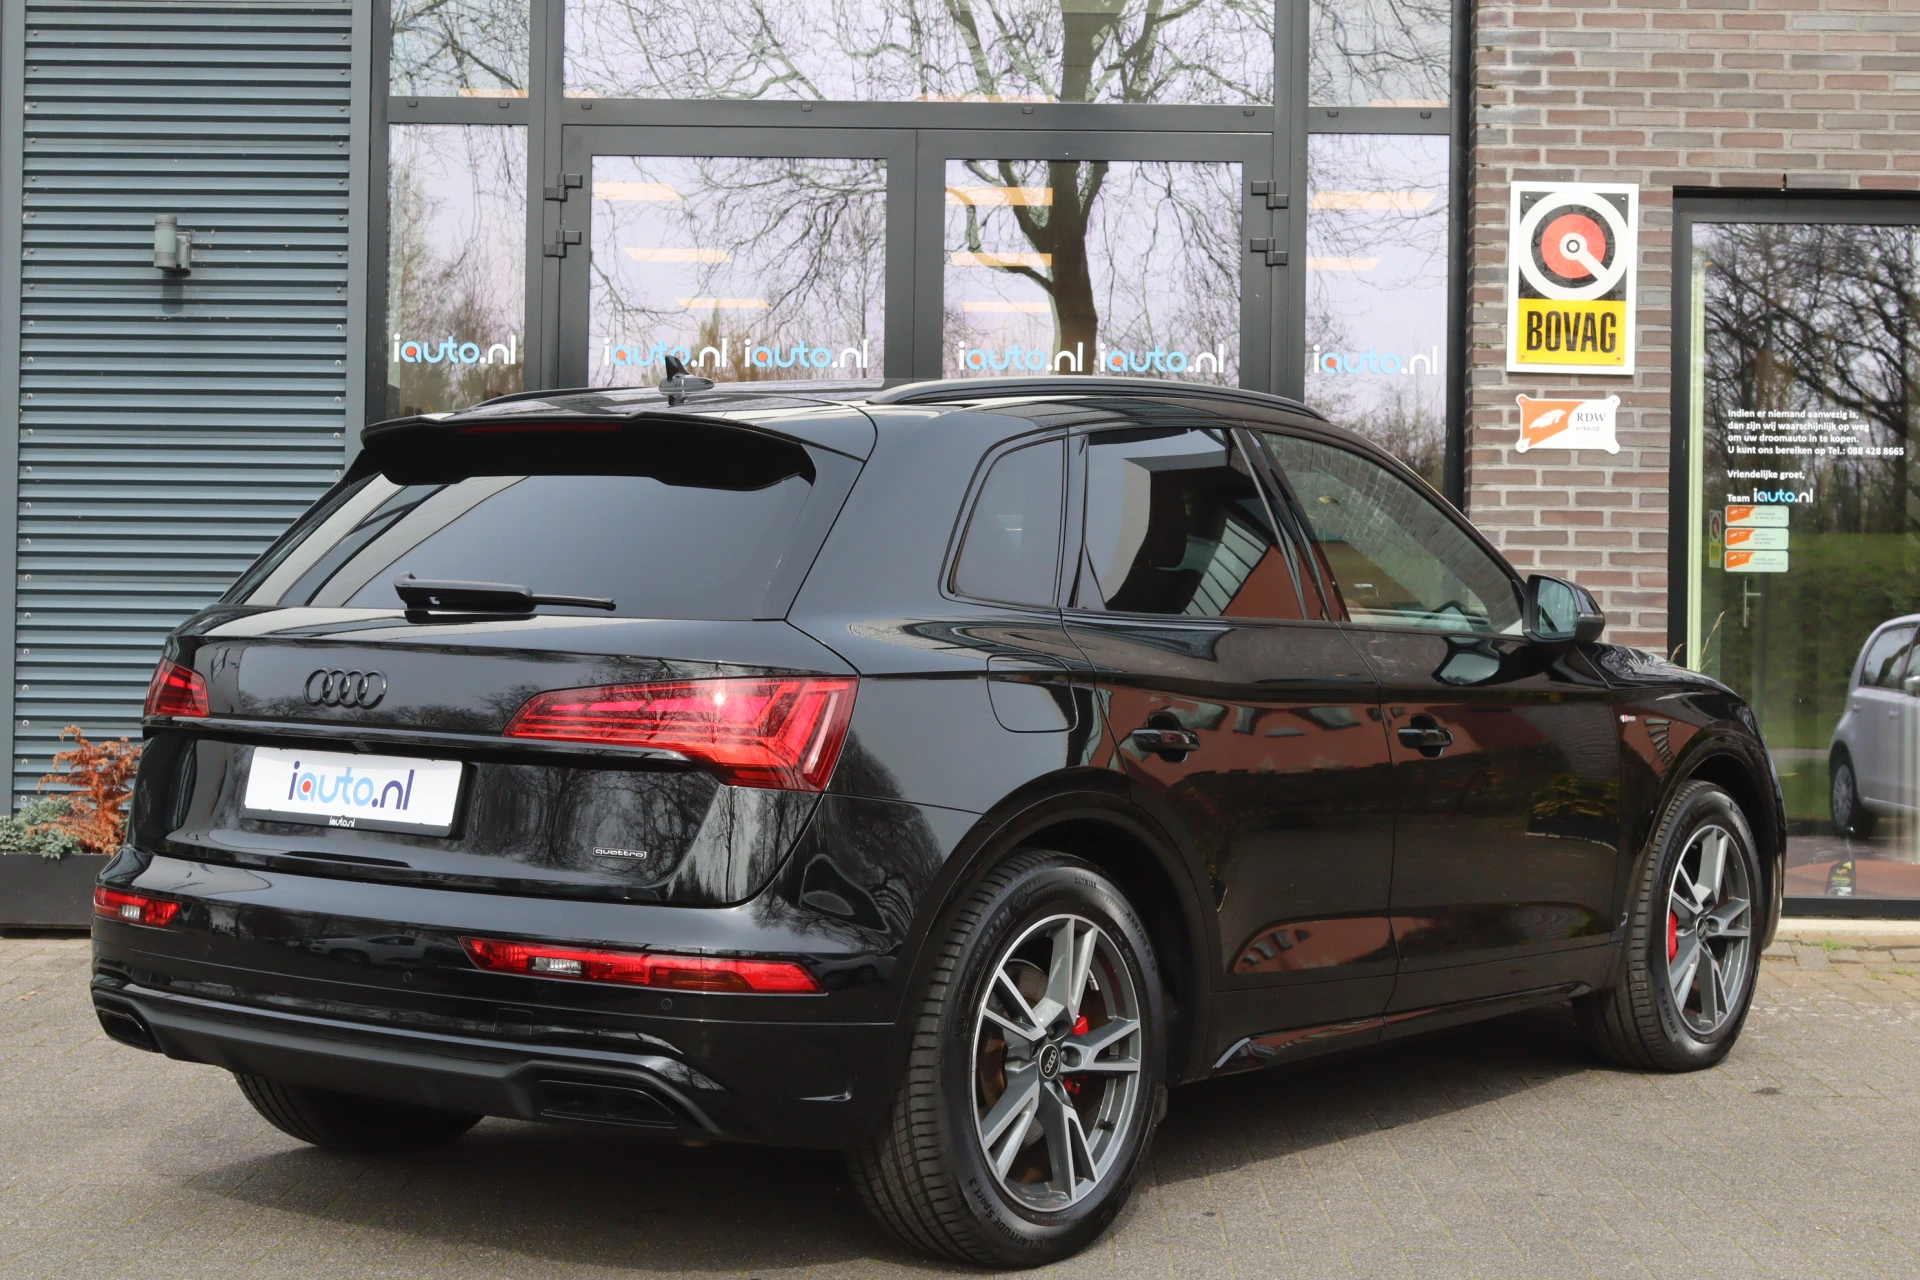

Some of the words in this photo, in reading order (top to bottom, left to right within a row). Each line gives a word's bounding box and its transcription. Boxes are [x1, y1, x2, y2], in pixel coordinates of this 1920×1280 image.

[1526, 311, 1617, 353] BOVAG
[393, 333, 517, 365] iauto.nl
[744, 338, 869, 369] iauto.nl
[958, 341, 1083, 372] iauto.nl
[1100, 343, 1224, 374] iauto.nl
[1312, 344, 1438, 375] iauto.nl
[1576, 412, 1606, 422] RDW
[1728, 409, 1755, 418] Indien
[1768, 410, 1805, 418] niemand
[1807, 410, 1847, 420] aanwezig
[1849, 410, 1859, 419] is,
[1728, 422, 1744, 430] dan
[1746, 422, 1761, 431] zijn
[1763, 422, 1776, 431] wij
[1728, 434, 1742, 442] om
[1744, 434, 1757, 442] uw
[1759, 434, 1807, 442] droomauto
[1809, 434, 1817, 442] in
[1830, 435, 1859, 443] kopen.
[1728, 445, 1735, 454] U
[1736, 445, 1756, 454] kunt
[1775, 445, 1812, 454] bereiken
[1814, 448, 1826, 456] op
[1847, 447, 1863, 455] 088
[1865, 447, 1881, 455] 428
[1883, 447, 1904, 456] 8665
[1727, 470, 1778, 480] Vriendelijke
[1780, 471, 1806, 480] groet,
[1727, 494, 1750, 502] Team
[1753, 487, 1814, 503] iauto.nl
[288, 760, 415, 810] iauto.nl
[594, 848, 644, 858] quattro
